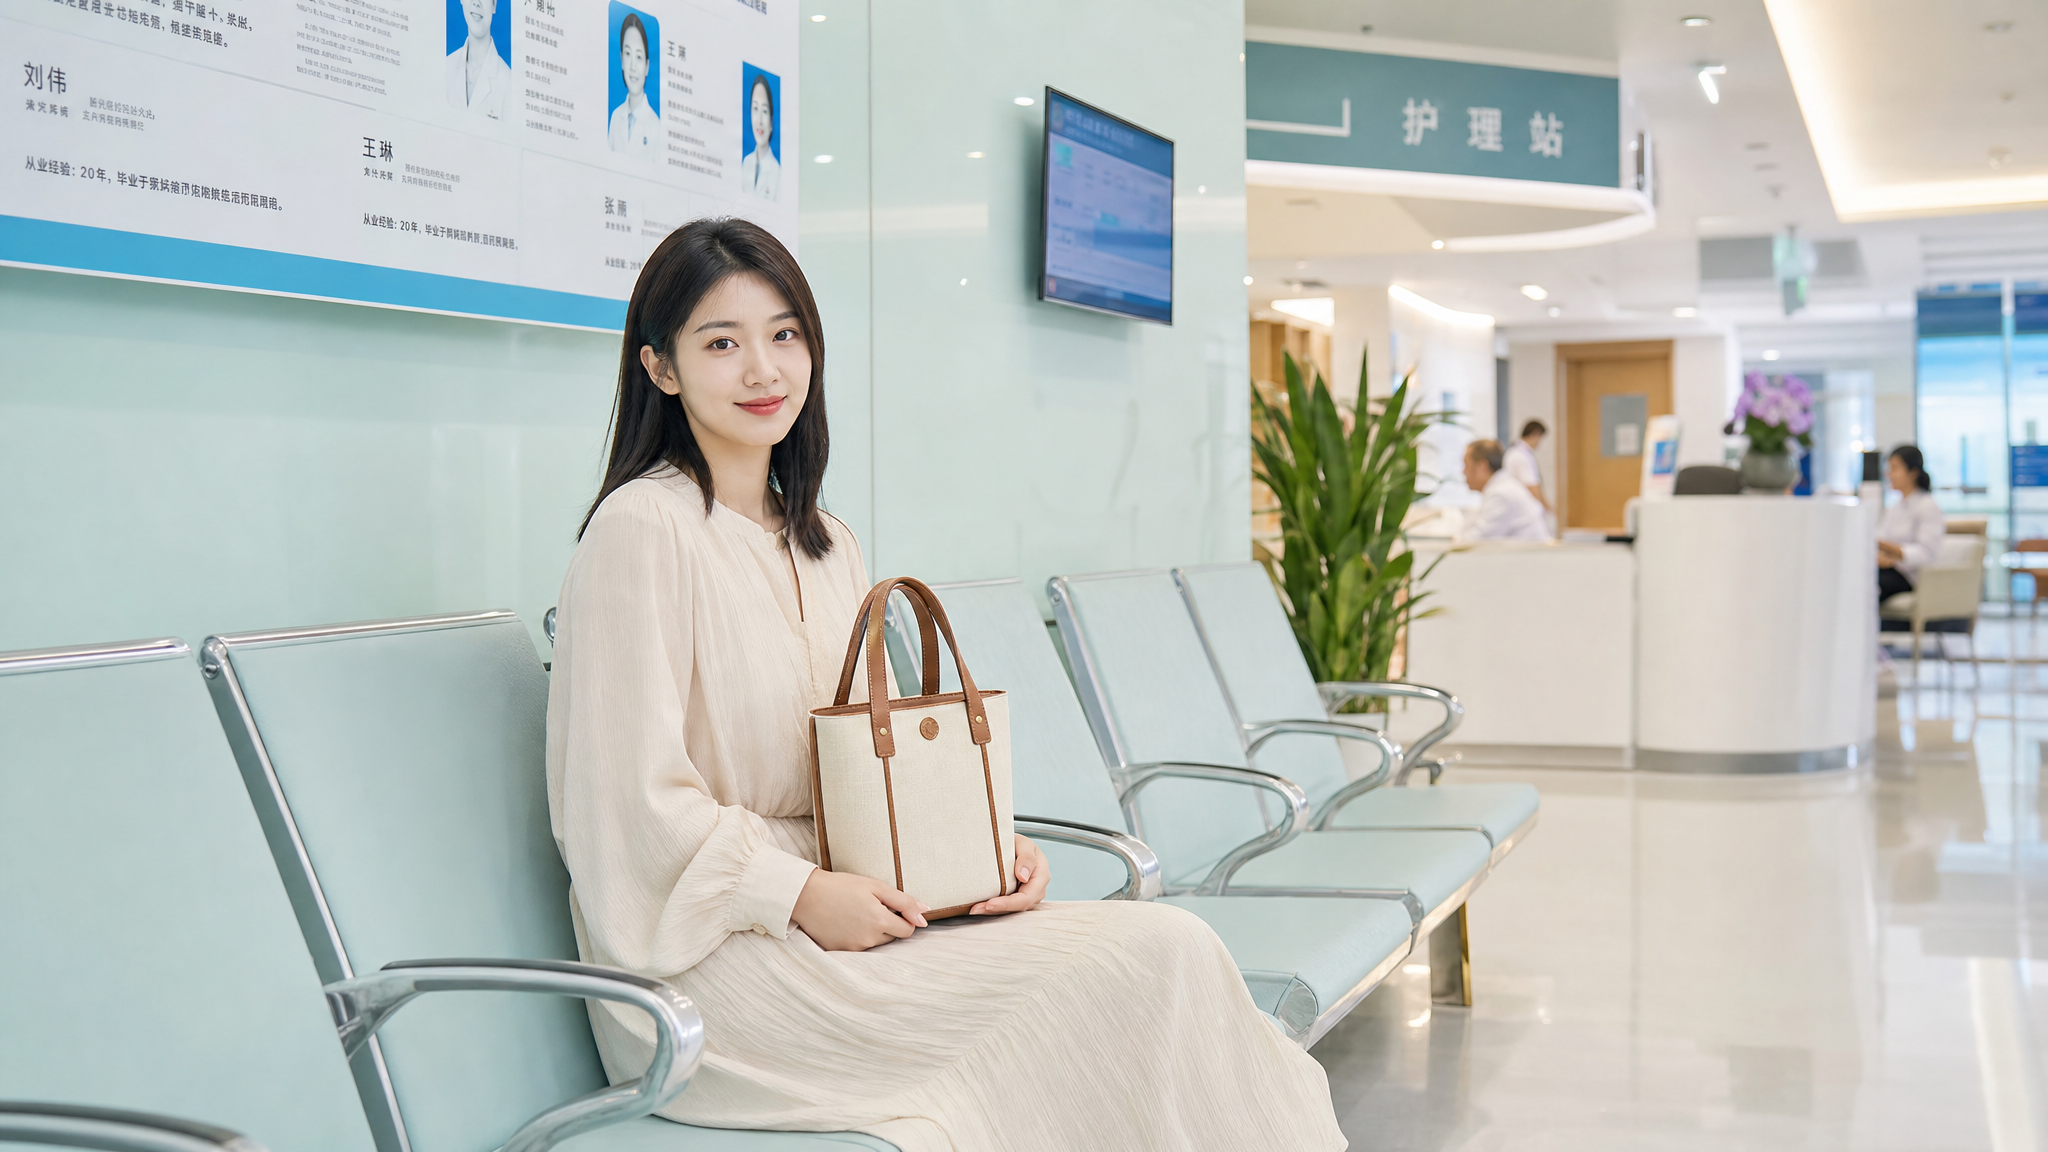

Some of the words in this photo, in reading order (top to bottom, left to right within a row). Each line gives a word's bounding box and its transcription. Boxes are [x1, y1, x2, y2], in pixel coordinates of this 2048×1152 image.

[24, 61, 67, 94] 刘伟
[1402, 98, 1565, 158] 护理站
[362, 136, 394, 163] 王琳
